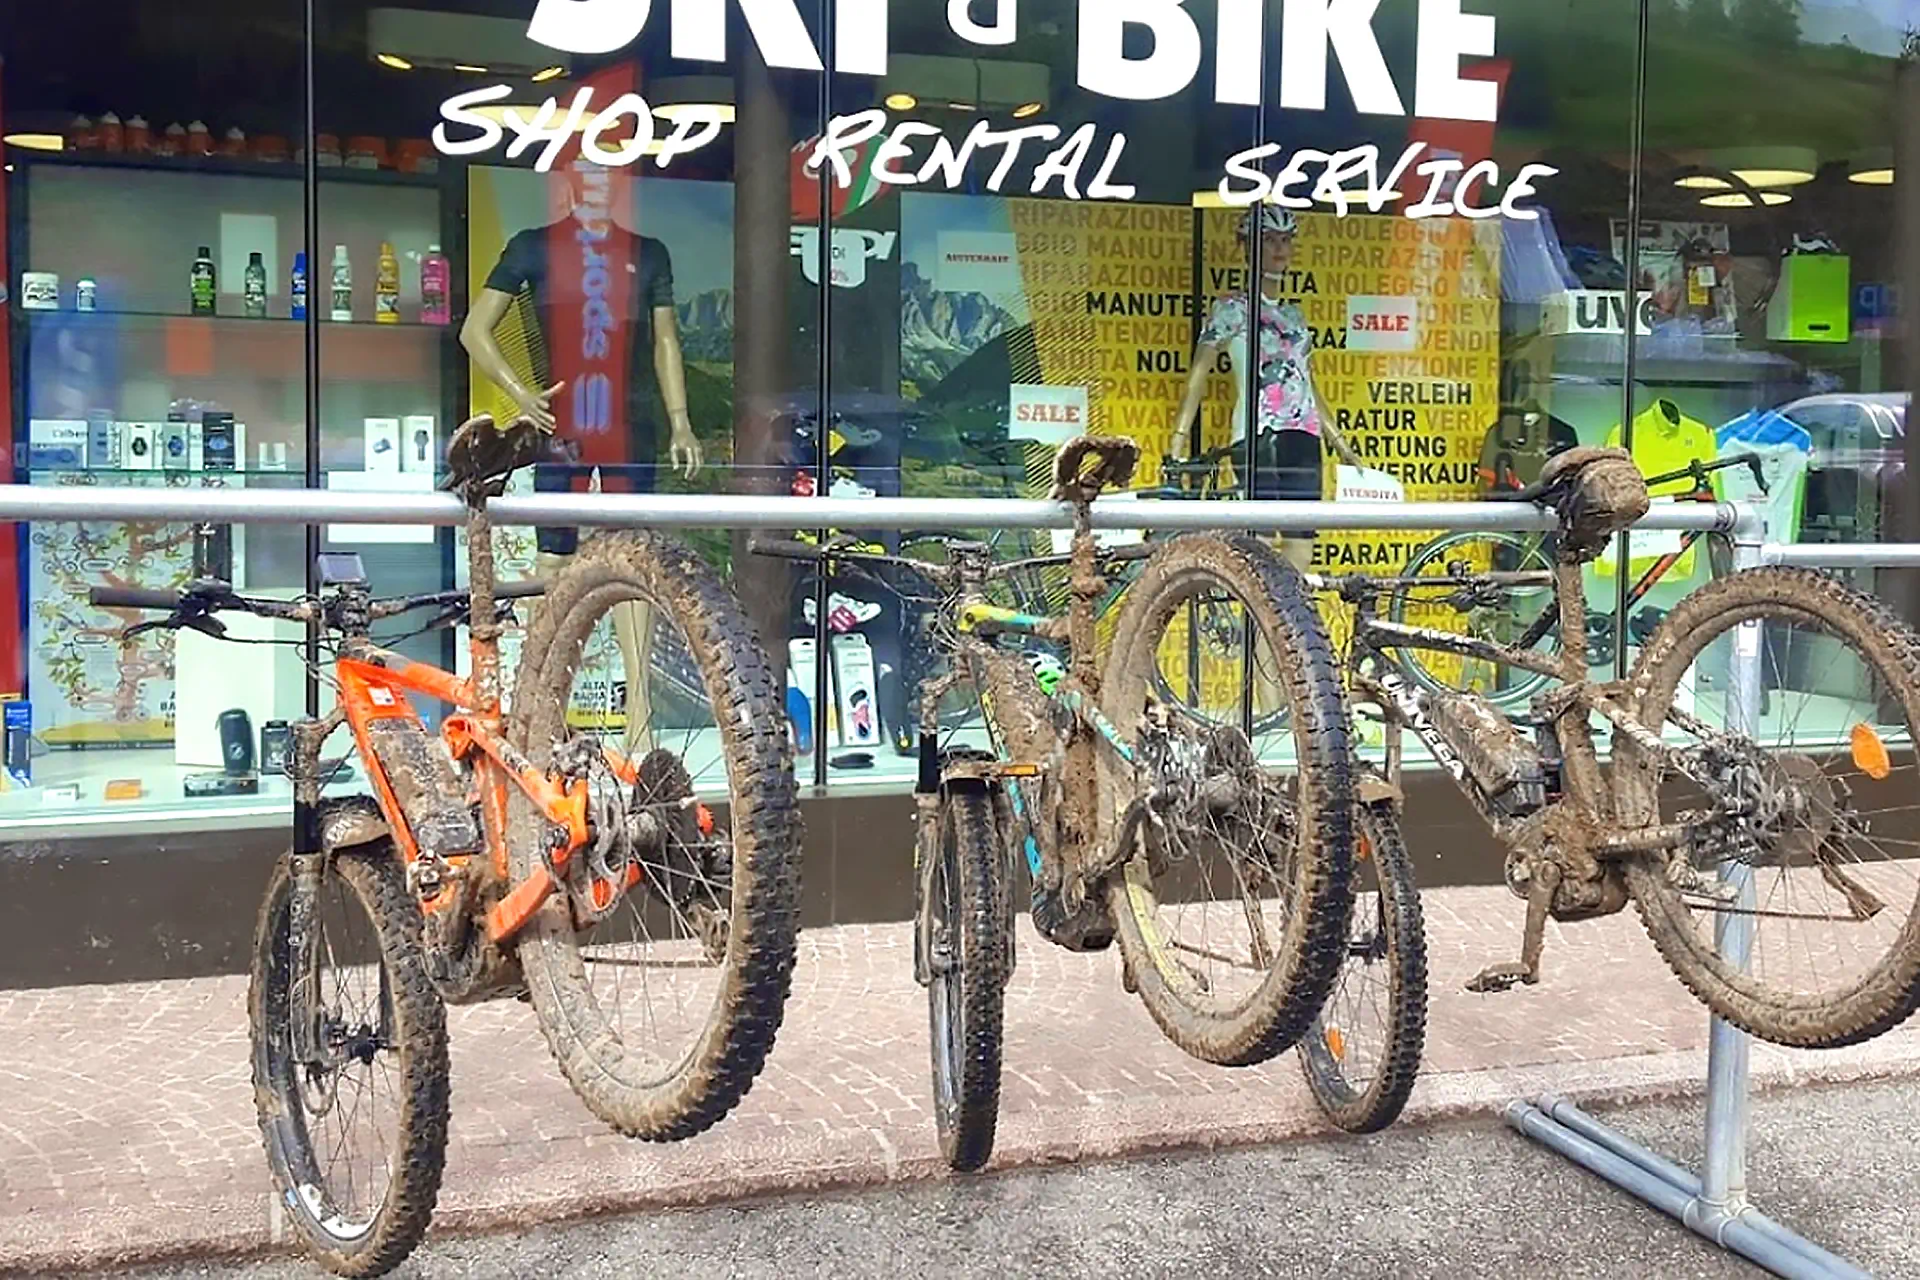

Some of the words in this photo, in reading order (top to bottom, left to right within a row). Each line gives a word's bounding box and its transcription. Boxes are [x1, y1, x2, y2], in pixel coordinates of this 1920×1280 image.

[432, 83, 723, 172] SHOP
[809, 108, 1136, 200] RENTAL
[1218, 142, 1560, 220] SERVICE
[1012, 202, 1192, 232] RIPARAZIONE
[1352, 314, 1409, 332] SALE
[1367, 383, 1471, 404] VERLEIH
[1016, 403, 1080, 423] SALE
[1337, 409, 1415, 431] RATUR
